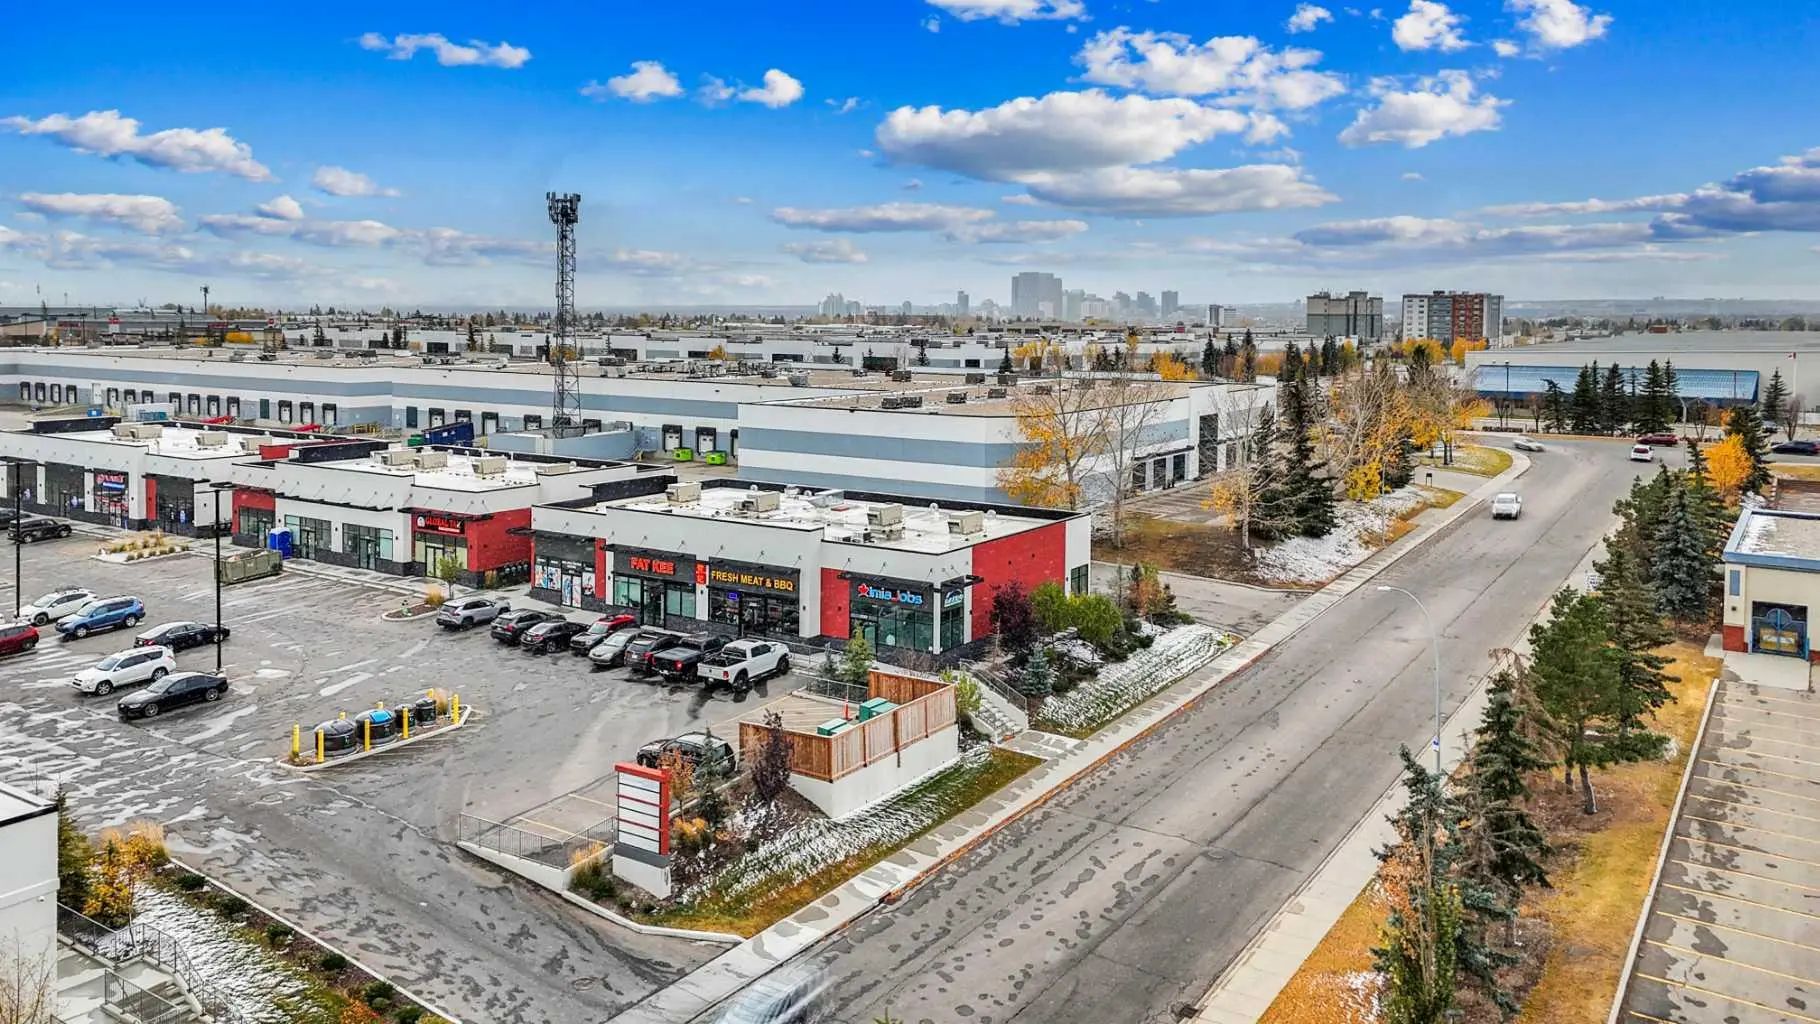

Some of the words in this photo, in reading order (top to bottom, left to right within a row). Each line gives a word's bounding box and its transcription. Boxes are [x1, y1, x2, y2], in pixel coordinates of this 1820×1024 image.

[631, 557, 650, 571] FAT
[652, 560, 674, 575] KEE
[711, 570, 739, 582] FRESH
[740, 574, 764, 586] MEAT
[765, 578, 772, 588] &
[774, 580, 794, 592] BBQ
